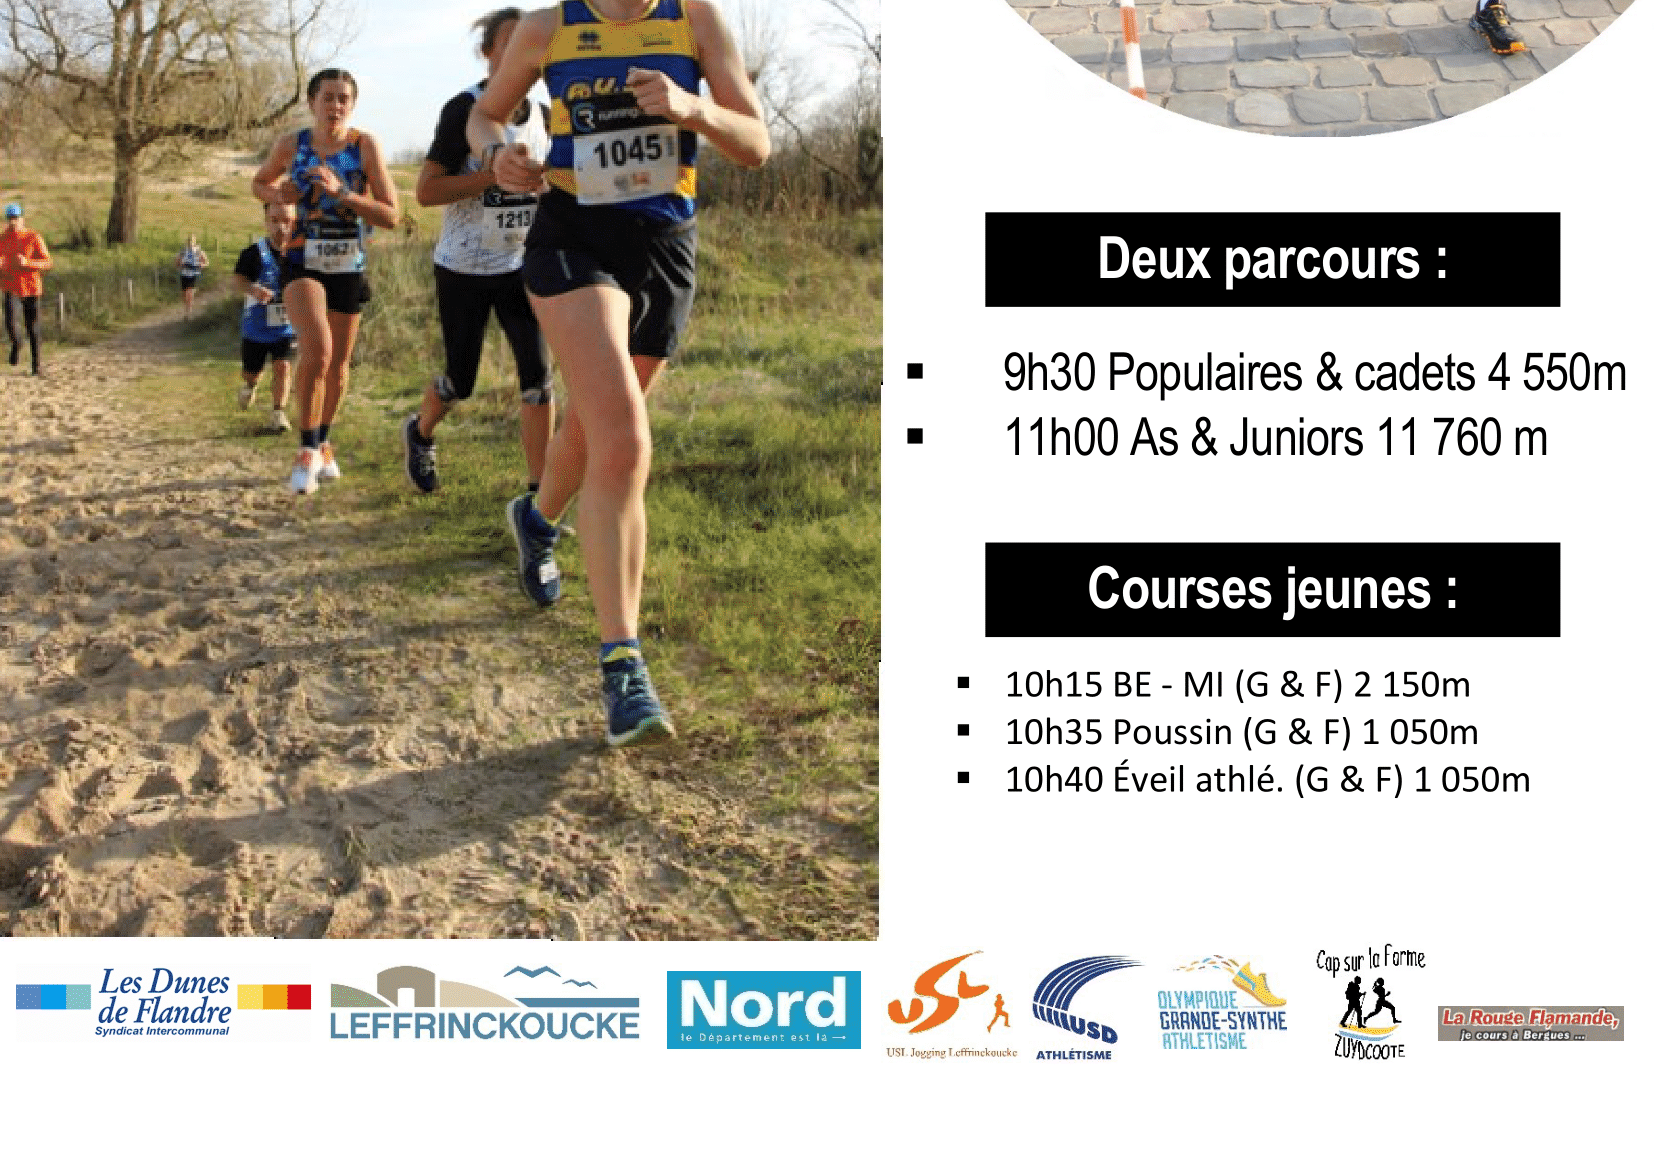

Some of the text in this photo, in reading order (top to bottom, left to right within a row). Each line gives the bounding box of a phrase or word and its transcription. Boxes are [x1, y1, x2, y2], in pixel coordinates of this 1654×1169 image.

[593, 134, 662, 169] 1045
[1100, 236, 1211, 279] Deux
[1226, 247, 1419, 290] parcours
[1005, 352, 1625, 400] 9h30 Populaires & cadets 4 550m
[1008, 417, 1546, 456] 11h00 As & Juniors 11 760 m
[1089, 566, 1271, 609] Courses
[1283, 566, 1430, 620] jeunes
[1008, 670, 1101, 697] 10h15
[1115, 672, 1150, 697] BE
[1185, 672, 1222, 697] MI
[1237, 670, 1267, 703] (G
[1281, 671, 1304, 697] &
[1317, 669, 1341, 703] F)
[1355, 672, 1371, 697] 2
[1385, 672, 1469, 697] 150m
[1008, 717, 1477, 751] 10h35 Poussin (G & F) 1 050m
[1008, 759, 1529, 798] 10h40 Éveil athlé. (G & F) 1 050m
[1316, 949, 1340, 978] Cap
[1344, 954, 1364, 972] sur
[1368, 947, 1380, 968] la
[99, 968, 229, 993] Les Dunes
[99, 996, 231, 1023] de Flandre
[681, 976, 846, 1028] Nord
[1158, 990, 1238, 1009] OLYMPIQUE
[95, 1026, 229, 1037] Syndicat Intercommunal
[331, 1012, 639, 1039] LEFFRINCKOUCKE
[1069, 1014, 1118, 1044] USD
[1160, 1011, 1287, 1030] GRANDE-SYNTHE
[1443, 1007, 1619, 1029] La Rouge Flamande,
[680, 1033, 693, 1042] le
[699, 1032, 784, 1044] Département
[791, 1033, 810, 1042] est
[1334, 1033, 1405, 1060] ZUYDCOOTE
[1460, 1030, 1472, 1041] je
[1475, 1031, 1507, 1040] cours
[1523, 1030, 1570, 1041] Bergues
[886, 1047, 908, 1057] USL
[911, 1047, 946, 1059] Jogging
[1035, 1047, 1112, 1060] ATHLÉTISME
